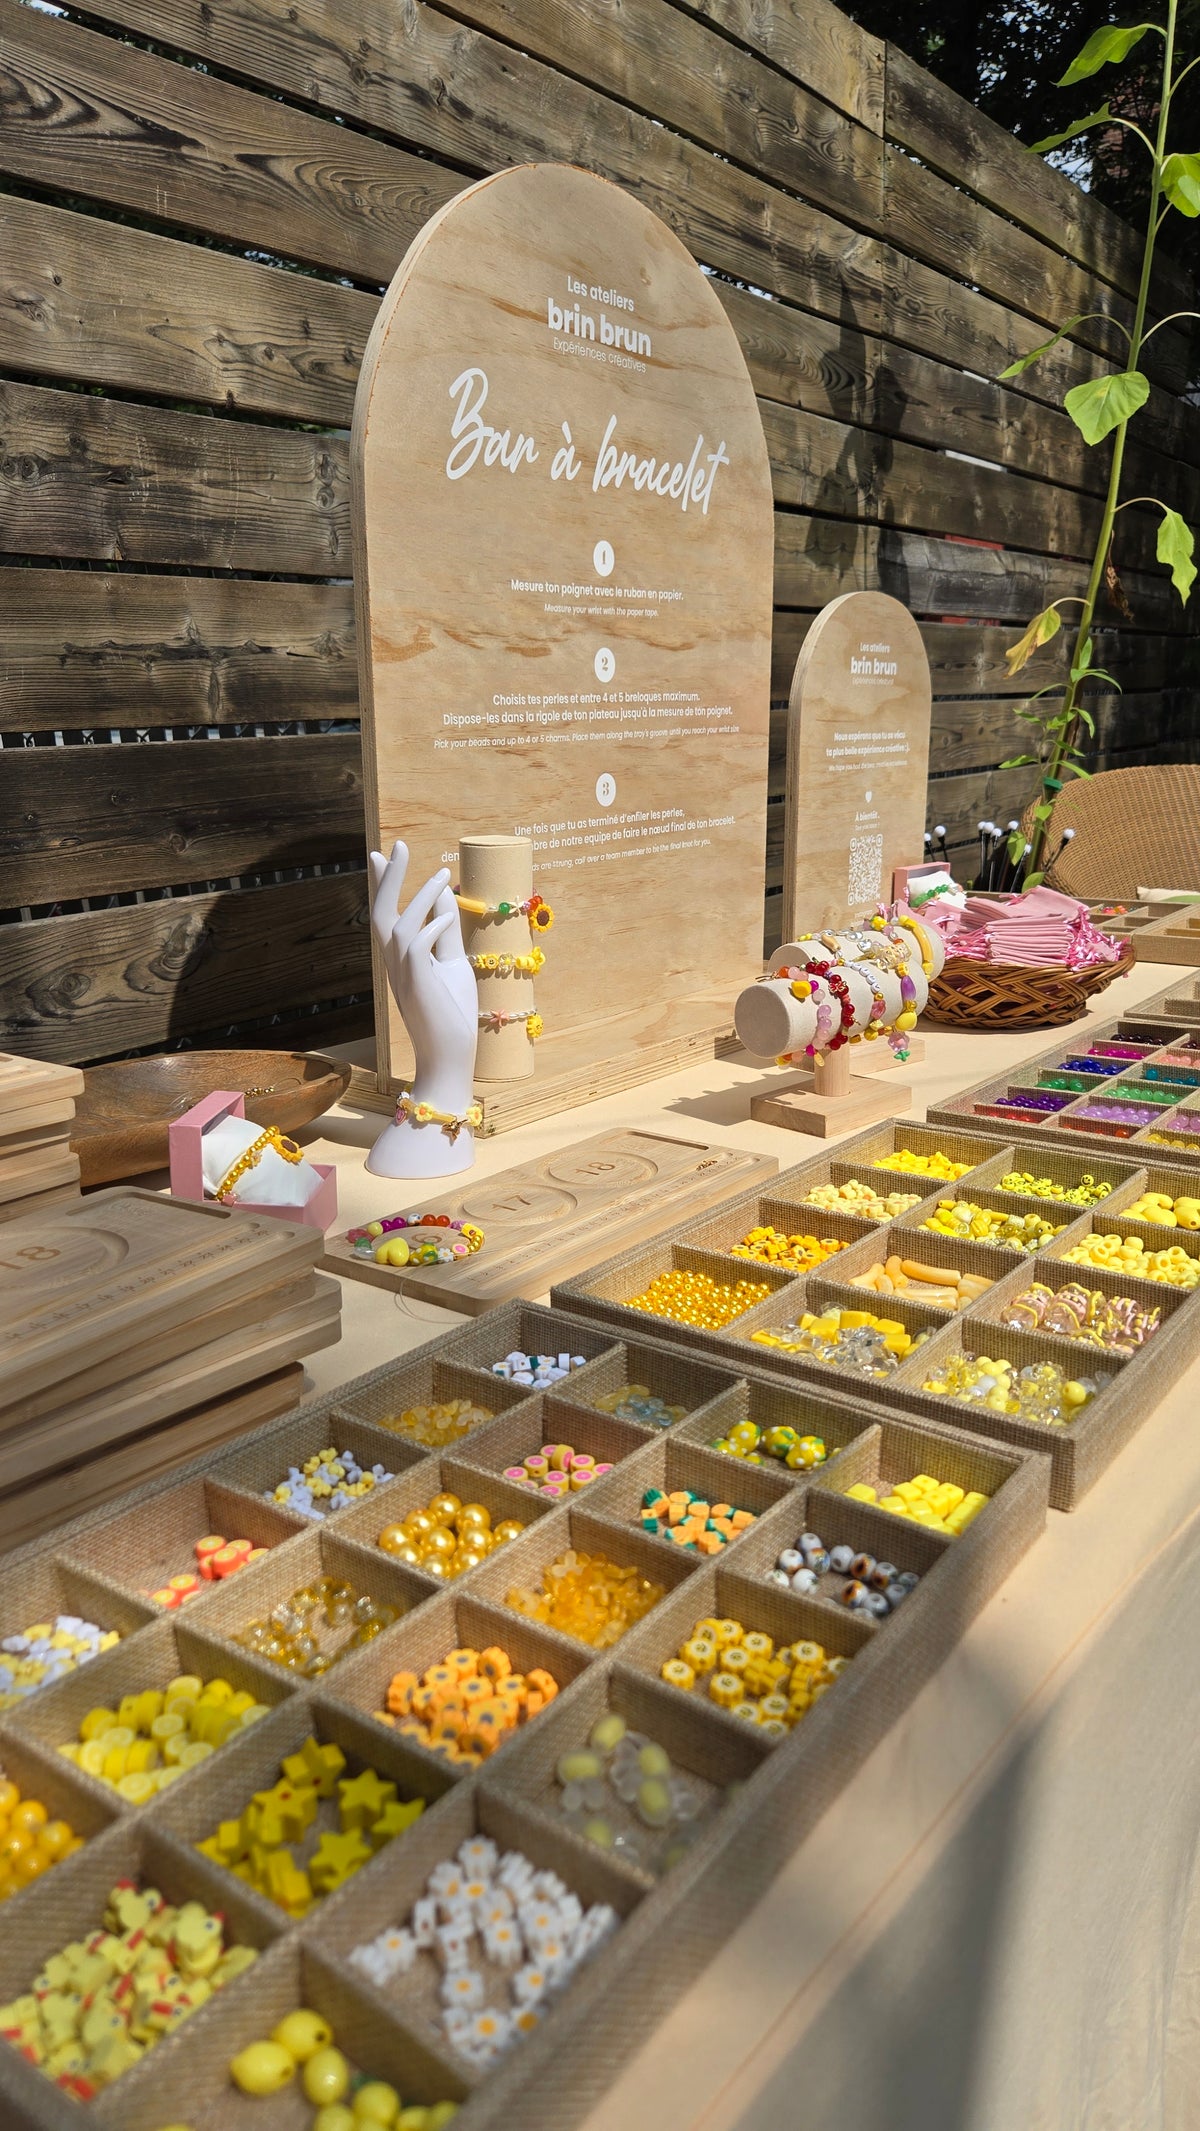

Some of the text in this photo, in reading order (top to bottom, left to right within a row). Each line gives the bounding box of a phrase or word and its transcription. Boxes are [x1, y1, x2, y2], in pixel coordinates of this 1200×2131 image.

[567, 275, 634, 312] Les ateliers
[547, 297, 652, 357] brin brun
[553, 337, 647, 373] Expériences créatives
[446, 367, 730, 515] Bar à bracelet
[601, 549, 607, 565] 1
[511, 579, 684, 603] Mesure ton poignet avec le ruban en papier.
[544, 603, 572, 614] Measure
[573, 606, 587, 617] your
[587, 606, 602, 616] wrist
[603, 606, 616, 617] with
[616, 607, 626, 617] the
[626, 609, 645, 619] paper
[860, 642, 891, 653] Les ateliers
[601, 656, 609, 671] 2
[850, 655, 897, 676] brin brun
[493, 690, 701, 708] Choisis tes perles et entre 4 et 5 breloques maximum.
[442, 704, 733, 728] Dispose-les dans la rigole de ton plateau jusqu'à la mesure de ton poignet.
[433, 739, 449, 750] Pick
[449, 739, 468, 751] your
[468, 737, 491, 748] beads
[491, 736, 507, 747] and
[507, 737, 517, 749] up
[517, 735, 526, 745] to
[525, 735, 531, 744] 4
[531, 735, 540, 745] or
[539, 734, 545, 744] 5
[572, 731, 589, 742] Place
[589, 729, 606, 741] them
[606, 730, 623, 742] along
[623, 729, 633, 740] the
[633, 729, 649, 740] tray's
[649, 729, 668, 740] groove
[669, 727, 681, 736] until
[681, 727, 692, 738] you
[706, 727, 718, 737] your
[833, 732, 848, 742] Nous
[848, 730, 872, 743] espérons
[832, 747, 845, 759] plus
[857, 744, 886, 758] expérience
[602, 781, 610, 796] 3
[514, 807, 686, 837] Une fois que tu as terminé d'enfiler les perles,
[549, 836, 561, 850] de
[561, 835, 584, 848] notre
[584, 831, 612, 847] equipe
[612, 829, 623, 841] de
[623, 827, 640, 838] faire
[640, 826, 649, 836] le
[648, 823, 671, 835] nœud
[671, 821, 687, 833] final
[687, 819, 696, 830] de
[696, 819, 708, 829] ton
[708, 815, 736, 828] bracelet.
[540, 861, 552, 871] are
[574, 856, 586, 866] call
[587, 854, 600, 864] over
[600, 853, 606, 862] a
[605, 851, 622, 862] team
[621, 846, 646, 859] member
[645, 846, 653, 855] to
[574, 1161, 616, 1176] 18
[491, 1194, 532, 1212] 17
